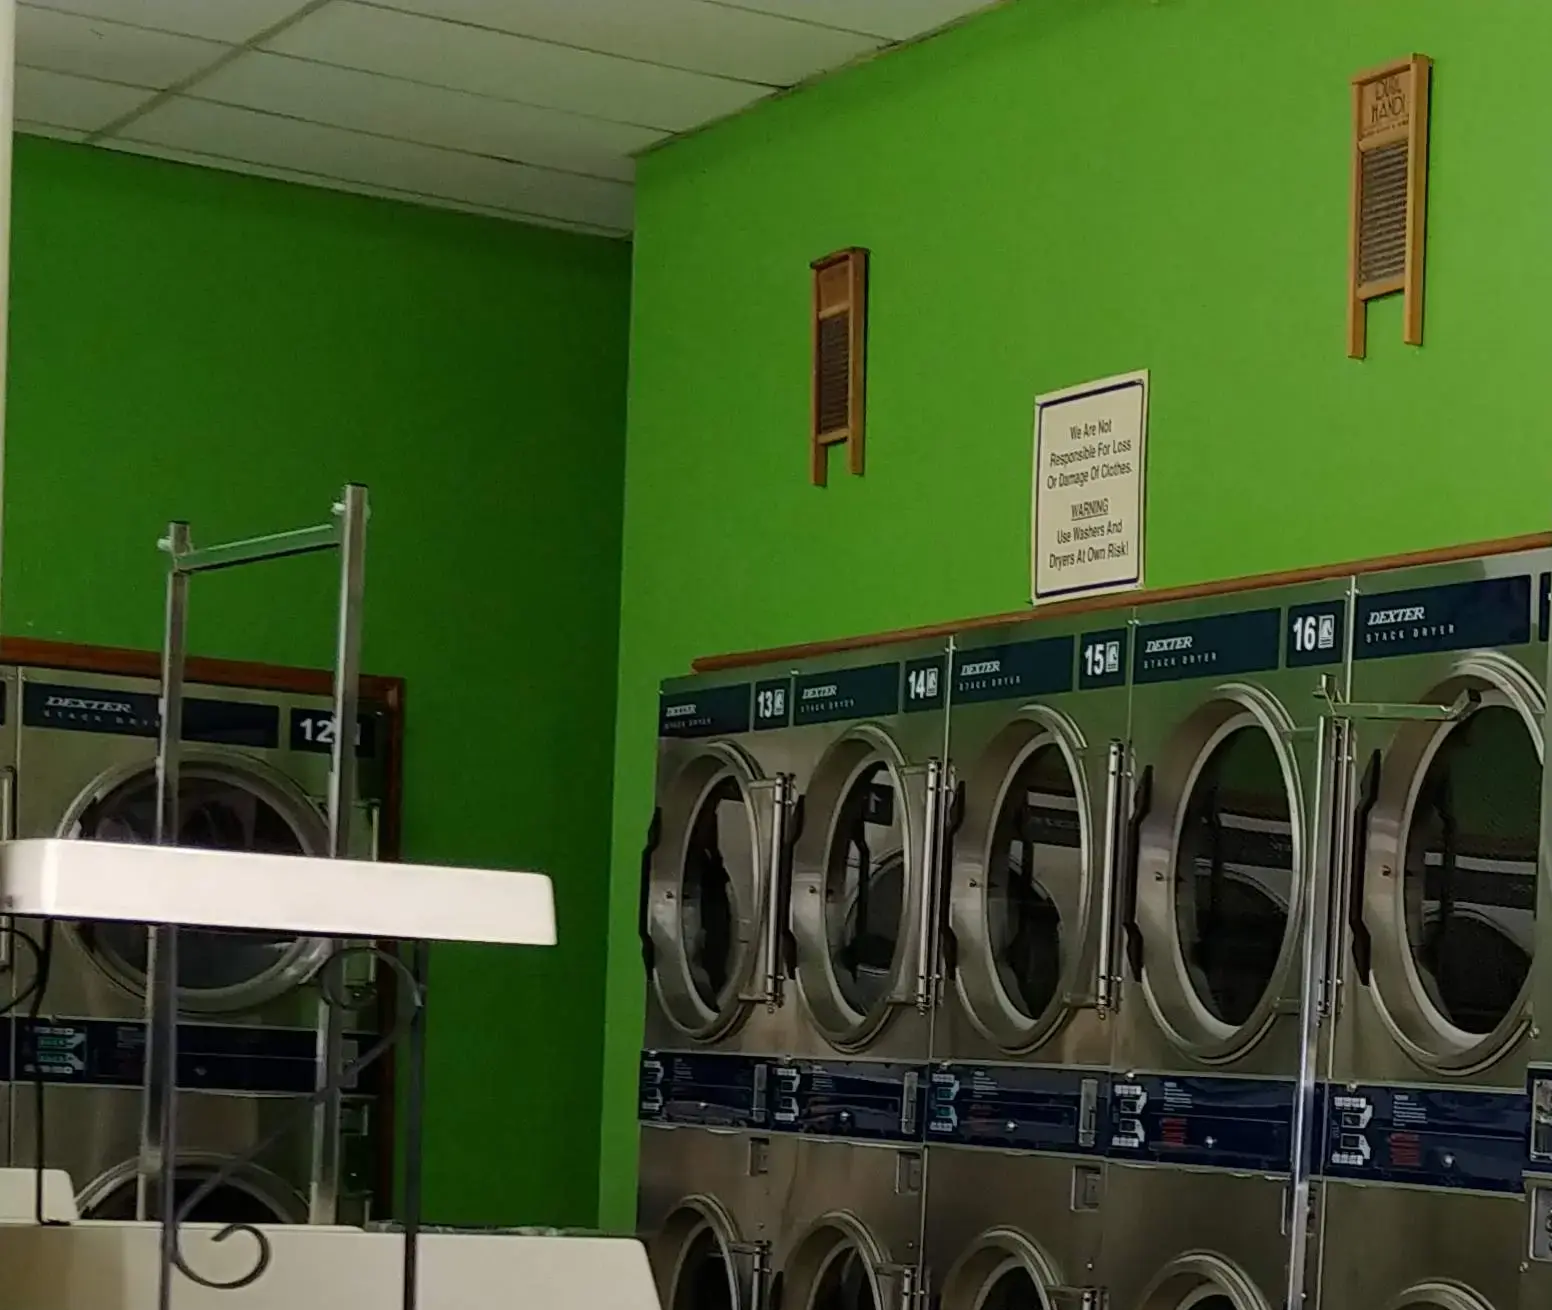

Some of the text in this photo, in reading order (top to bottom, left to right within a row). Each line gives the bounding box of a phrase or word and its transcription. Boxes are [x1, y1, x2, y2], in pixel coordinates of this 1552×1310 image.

[1069, 419, 1112, 440] We Are Not
[1050, 438, 1132, 468] Responsible For Loss
[1046, 475, 1057, 490] Or
[1058, 470, 1089, 489] Damage
[1090, 466, 1100, 481] Of
[1071, 498, 1109, 519] WARNING
[1056, 519, 1123, 544] Use Washers And
[1049, 541, 1129, 572] Dryers At Own Risk!
[1367, 606, 1425, 626] DEXTER
[1145, 636, 1192, 653] DEXTER
[1292, 616, 1317, 651] 16
[1366, 624, 1455, 643] STACK DRYER
[960, 660, 1000, 676] DEXTER
[1084, 644, 1104, 676] 15
[802, 685, 837, 699] DEXTER
[908, 670, 926, 699] 14
[45, 695, 132, 713] DEXTER
[757, 691, 773, 718] 13
[299, 718, 335, 743] 12
